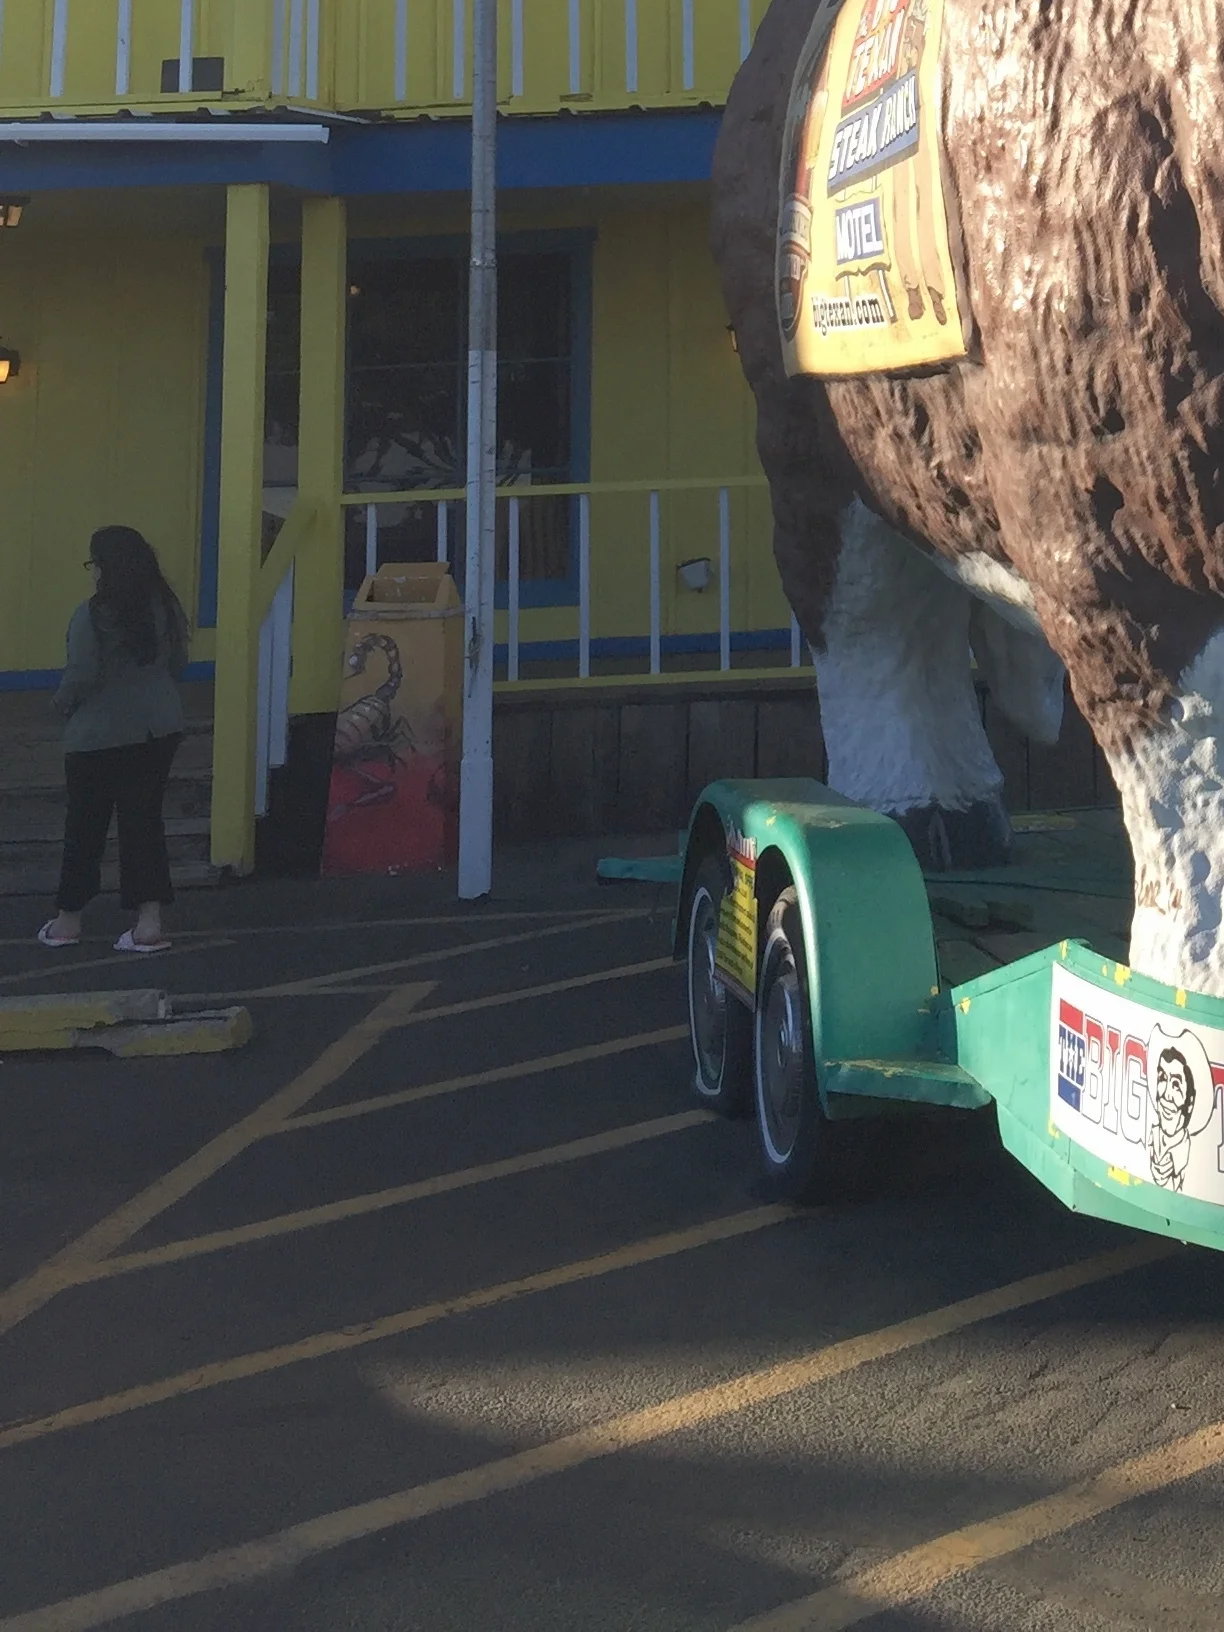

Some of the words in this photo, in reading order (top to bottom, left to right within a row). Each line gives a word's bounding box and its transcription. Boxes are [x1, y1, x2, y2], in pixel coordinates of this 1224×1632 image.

[846, 9, 904, 100] TEXAN
[828, 103, 883, 181] STEAK
[880, 75, 916, 152] RANCH
[836, 204, 883, 259] MOTEL
[811, 296, 885, 336] bigtexan.com
[1059, 1023, 1085, 1082] THE
[1081, 1013, 1148, 1144] BIG
